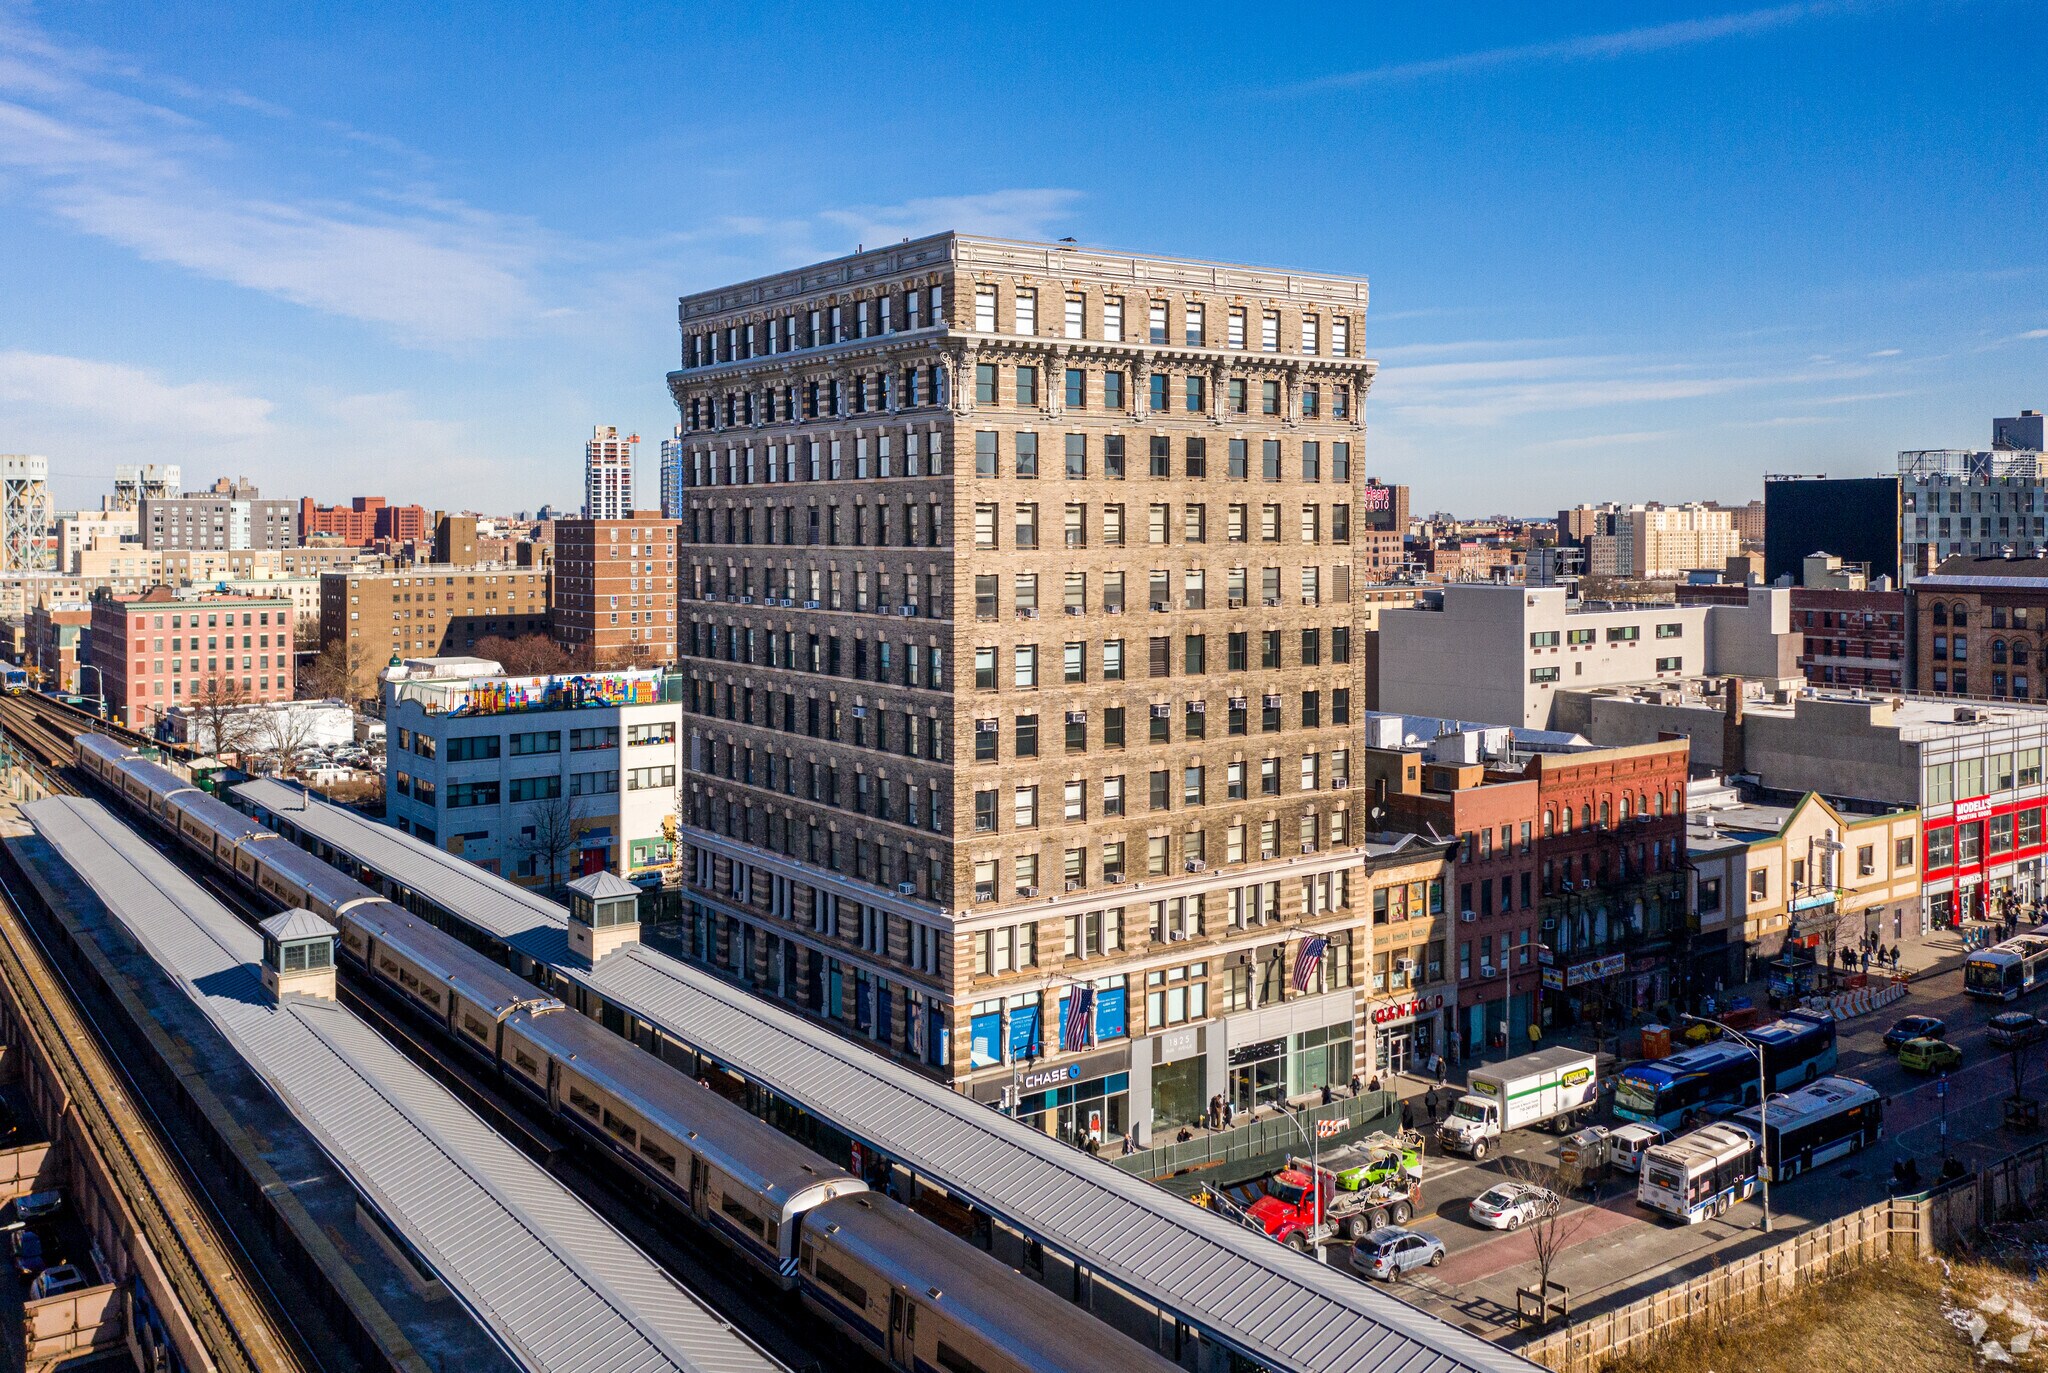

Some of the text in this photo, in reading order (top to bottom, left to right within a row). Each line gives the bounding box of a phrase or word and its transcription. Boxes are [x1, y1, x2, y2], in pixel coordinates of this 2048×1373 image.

[1364, 486, 1389, 500] Heart
[1364, 500, 1389, 510] RADIO
[1956, 798, 1992, 815] MODELL'S
[1411, 994, 1444, 1015] FOOD
[1169, 1034, 1190, 1046] 1825
[1025, 1068, 1068, 1088] CHASE
